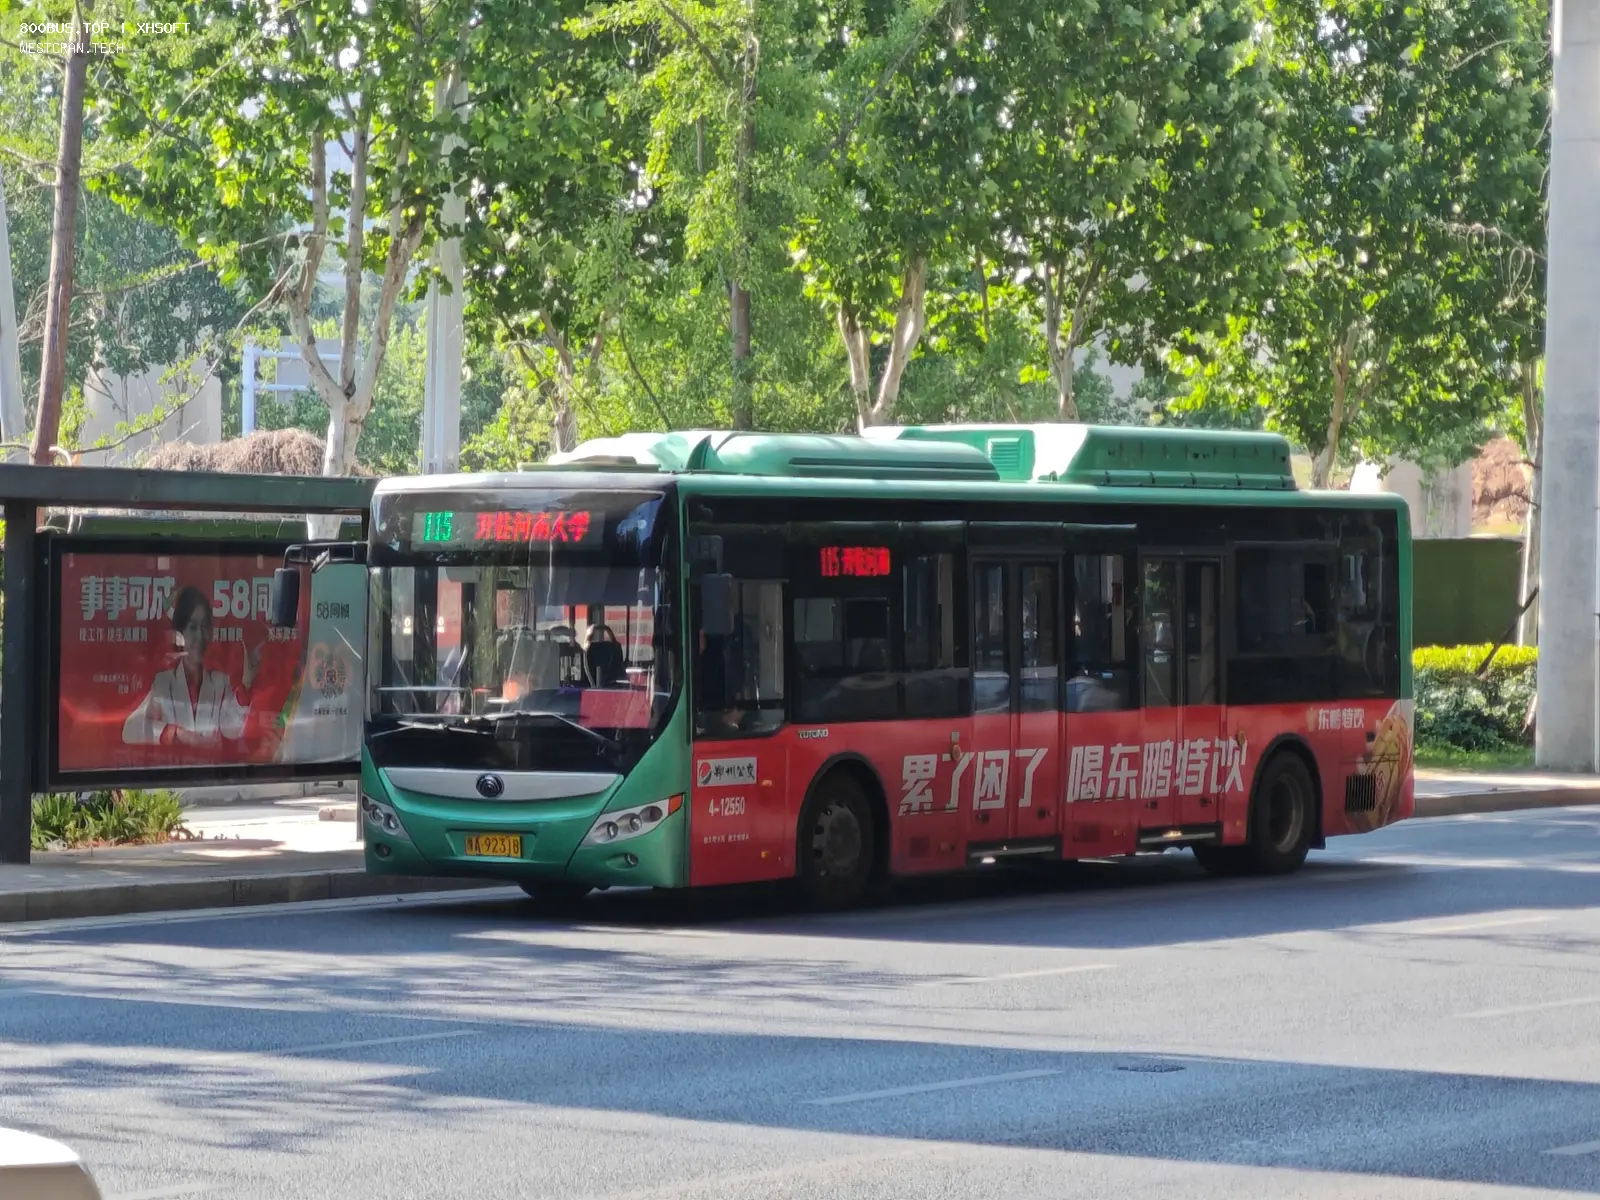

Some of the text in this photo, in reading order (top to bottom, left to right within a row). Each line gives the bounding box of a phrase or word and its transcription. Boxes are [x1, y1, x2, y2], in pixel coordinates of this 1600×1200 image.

[424, 511, 453, 541] 115
[212, 577, 298, 622] 58同
[1318, 707, 1365, 730] 东鹏特饮
[897, 735, 1248, 817] 累了困了 喝东鹏特饮
